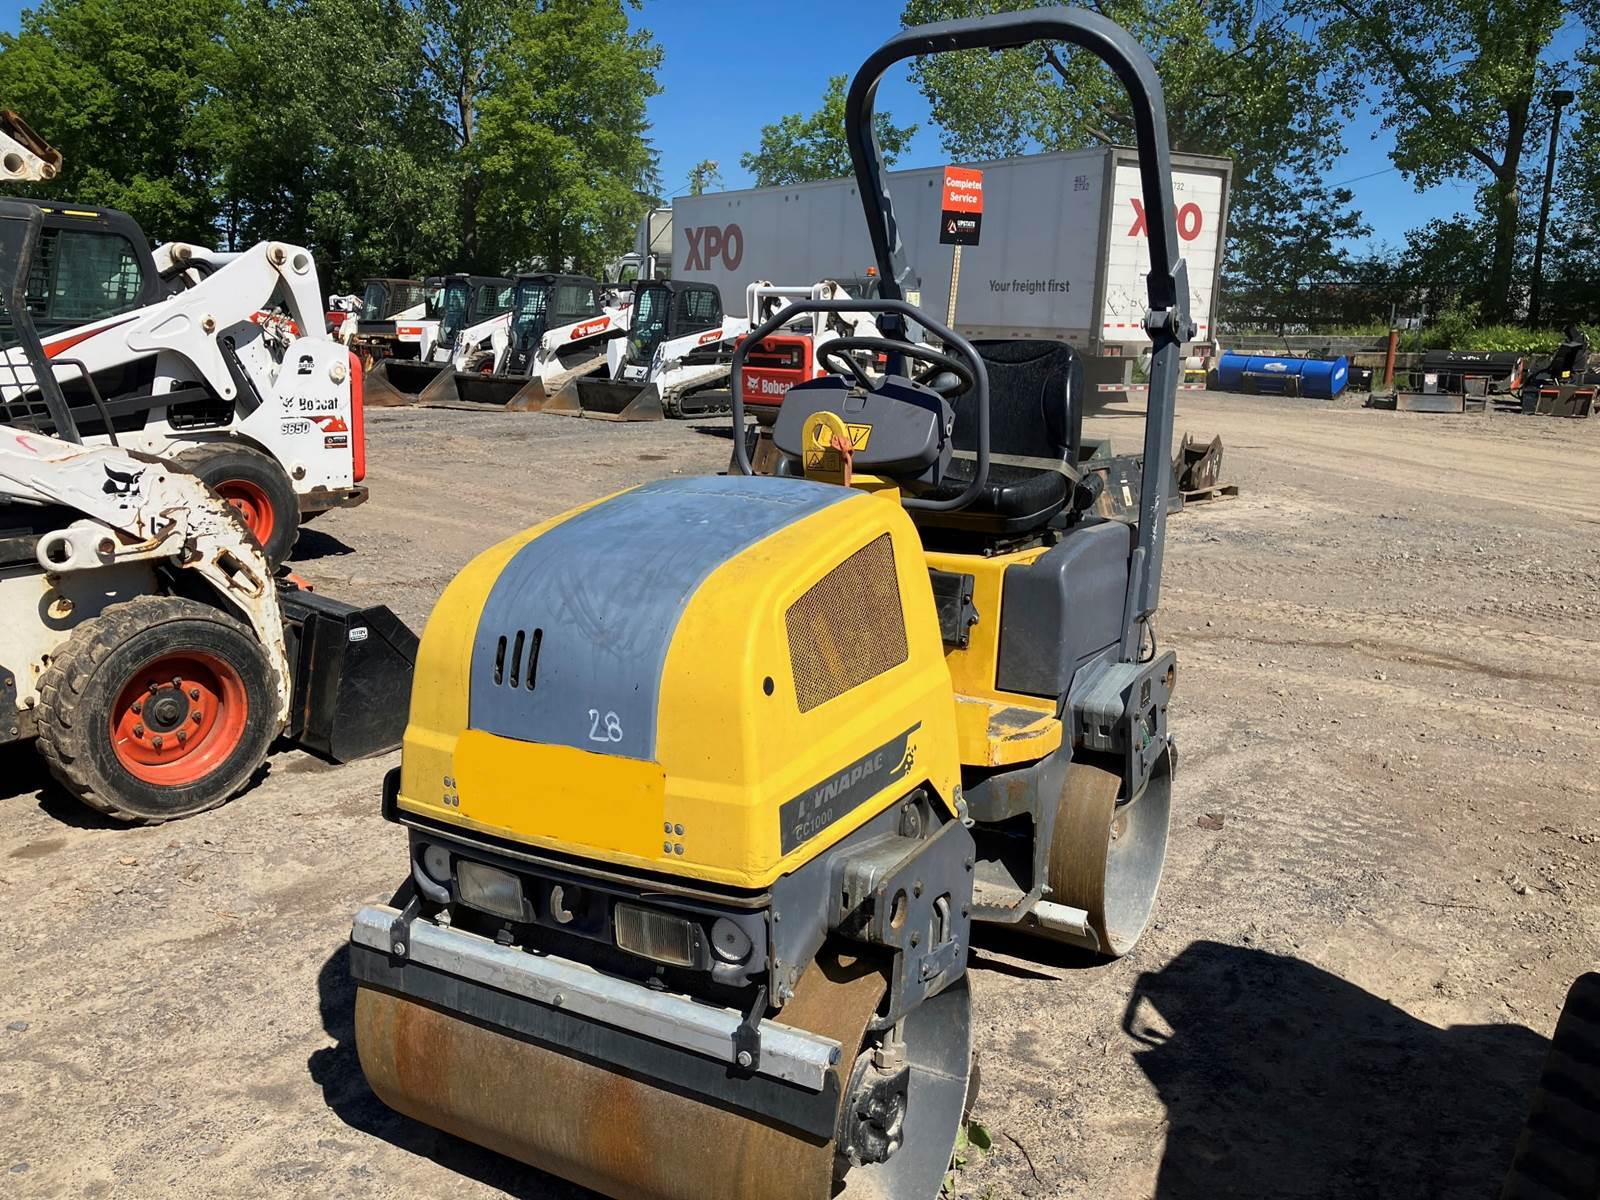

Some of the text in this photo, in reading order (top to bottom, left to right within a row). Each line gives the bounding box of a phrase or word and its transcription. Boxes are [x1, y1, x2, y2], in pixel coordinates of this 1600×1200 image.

[950, 192, 977, 203] Service
[1127, 198, 1203, 241] XO
[684, 223, 744, 272] XPO
[989, 279, 1070, 295] Your freight first
[281, 422, 311, 435] S650
[588, 708, 623, 742] 28
[795, 808, 833, 841] CC1000
